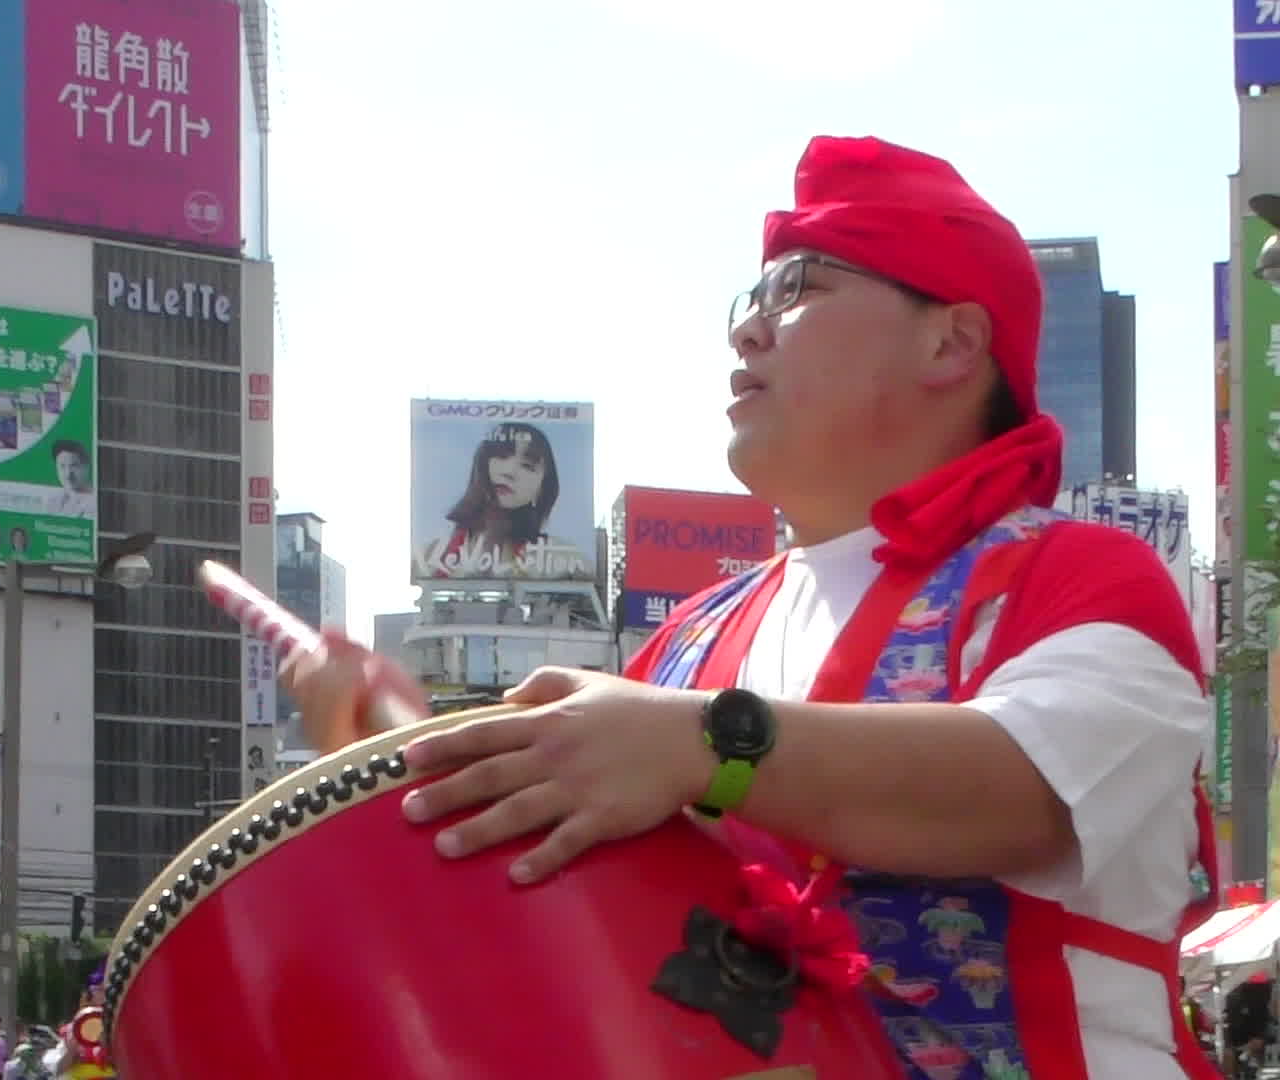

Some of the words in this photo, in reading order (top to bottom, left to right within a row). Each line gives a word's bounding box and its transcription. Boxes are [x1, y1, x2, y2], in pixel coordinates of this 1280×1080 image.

[75, 22, 190, 95] 龍角散
[57, 82, 212, 157] ダイレクト
[635, 517, 765, 553] PROMISE
